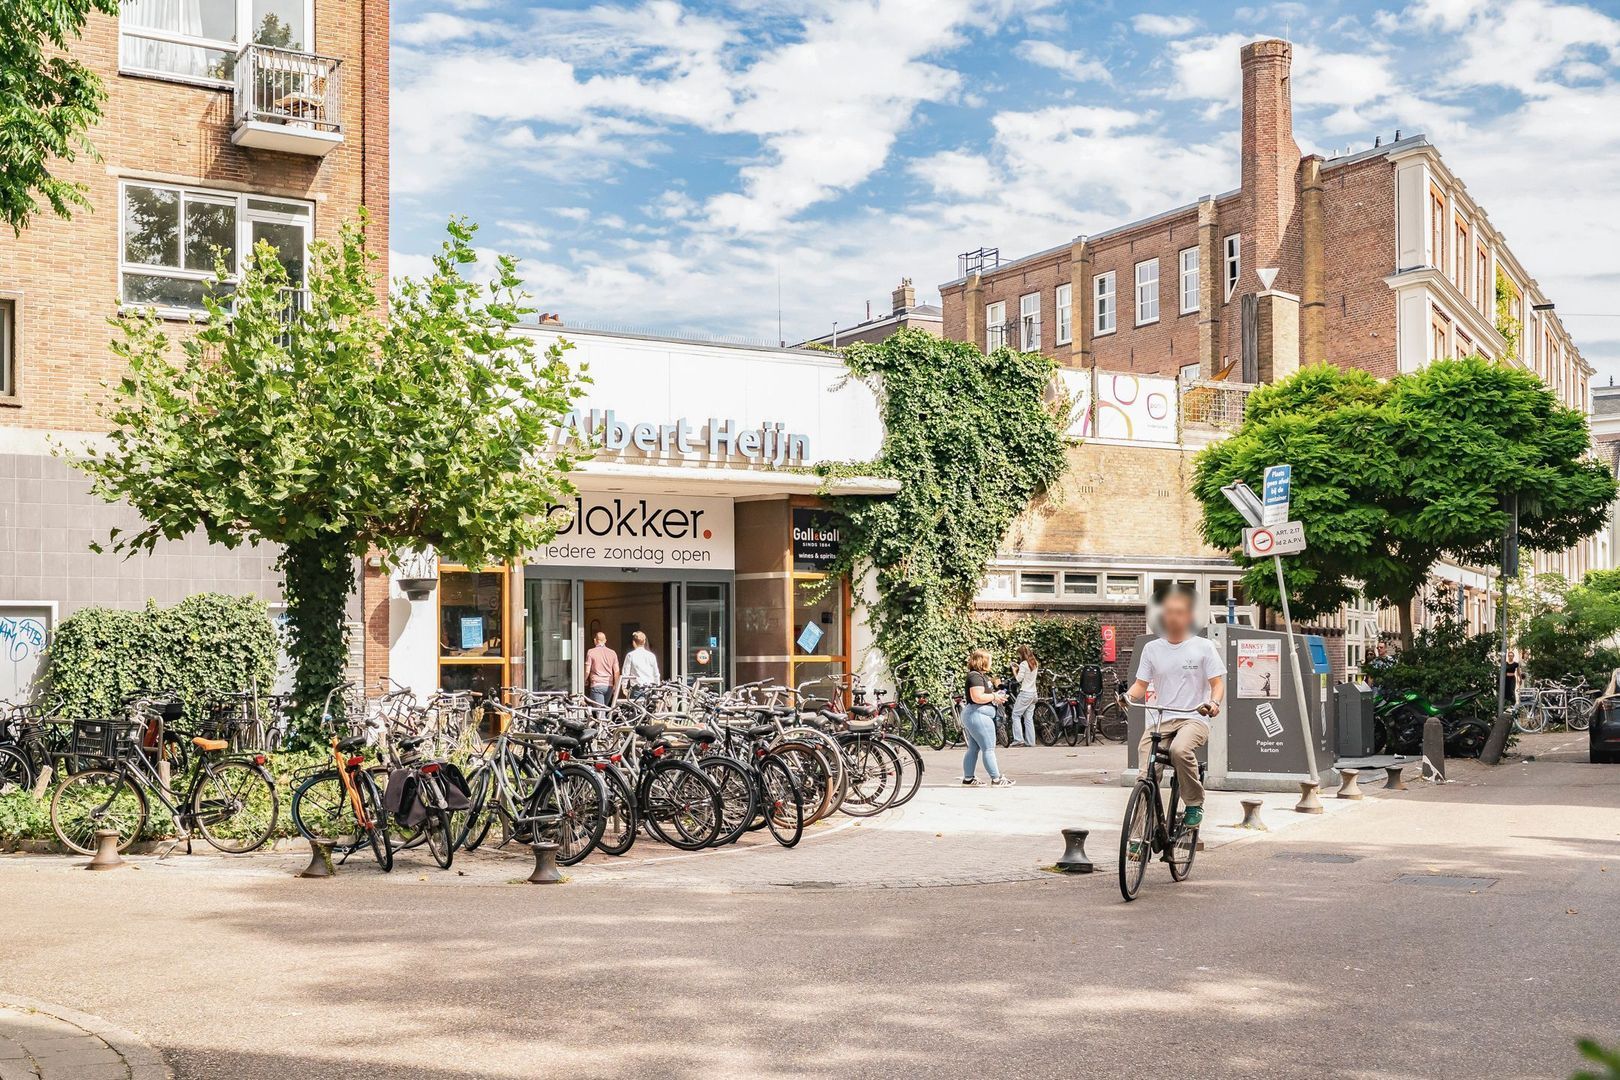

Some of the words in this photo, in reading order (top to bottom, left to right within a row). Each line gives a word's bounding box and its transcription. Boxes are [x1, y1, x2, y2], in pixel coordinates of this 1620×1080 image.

[556, 408, 693, 453] Albert
[707, 418, 810, 469] Heijn
[794, 527, 839, 542] Gall&Gall
[545, 544, 596, 559] iedere
[604, 546, 664, 565] zondag
[672, 549, 711, 565] open
